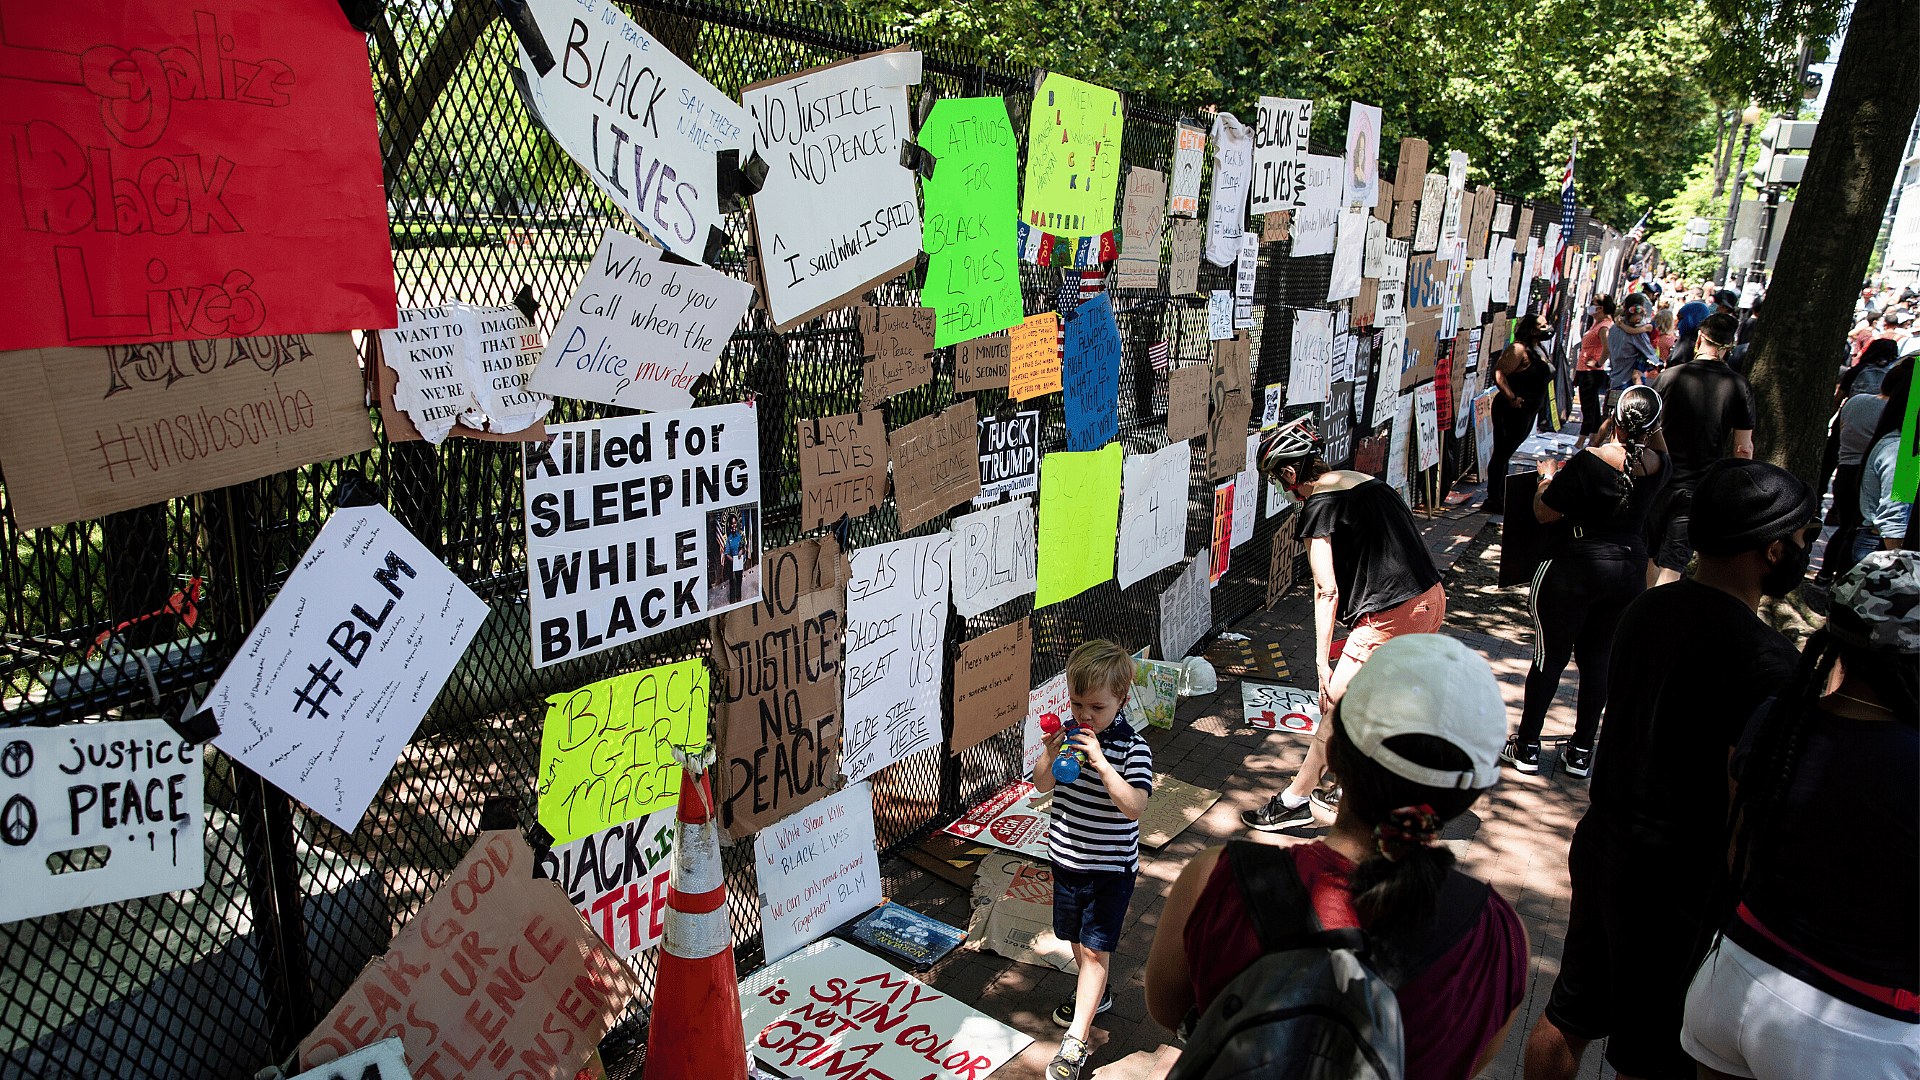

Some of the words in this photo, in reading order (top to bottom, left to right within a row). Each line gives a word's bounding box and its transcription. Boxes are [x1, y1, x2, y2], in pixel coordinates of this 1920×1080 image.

[620, 23, 650, 52] PEACE
[563, 18, 666, 138] BLACK
[678, 88, 705, 119] SAY
[710, 109, 741, 141] THEIR
[751, 95, 786, 149] NO
[1256, 107, 1293, 149] BLACK
[789, 143, 827, 184] NO
[1294, 103, 1311, 206] MATTER
[592, 114, 698, 245] LIVES
[962, 162, 992, 196] FOR
[1252, 160, 1293, 204] LIVES
[784, 253, 804, 288] I
[860, 220, 877, 247] I
[874, 200, 915, 238] SAID
[929, 214, 990, 254] BLACK
[54, 246, 266, 341] Lives
[604, 242, 652, 288] Who
[661, 272, 681, 298] do
[679, 288, 718, 315] you
[394, 326, 440, 344] WANT
[443, 323, 463, 338] TO
[400, 310, 414, 323] IF
[416, 306, 449, 321] YOU
[579, 293, 623, 321] Call
[630, 303, 680, 339] when
[686, 320, 712, 352] the
[881, 313, 909, 334] Justice
[942, 296, 995, 334] #BLM
[409, 344, 455, 363] KNOW
[481, 337, 516, 354] THAT
[520, 333, 542, 351] YOU
[482, 357, 512, 373] HAD
[555, 325, 628, 378] Police
[875, 336, 887, 359] No
[890, 337, 914, 358] Peace
[961, 346, 969, 365] 8
[976, 345, 1008, 360] MINUTES
[1092, 342, 1104, 363] TO
[1106, 336, 1117, 357] DO
[420, 364, 453, 382] WHY
[421, 383, 465, 401] WE'RE
[869, 365, 878, 387] No
[958, 370, 971, 385] 46
[976, 364, 1008, 379] SECONDS
[1069, 370, 1092, 399] WHAT
[1323, 390, 1350, 421] BLACK
[1327, 415, 1349, 440] LIVES
[90, 382, 315, 482] #unsubscribe
[526, 422, 652, 481] Killed
[665, 419, 725, 460] for
[900, 437, 932, 469] BLACK
[937, 428, 948, 448] IS
[951, 415, 975, 444] NOT
[988, 418, 1031, 451] FUCK
[1324, 436, 1350, 465] ATTER
[817, 445, 874, 476] LIVES
[910, 476, 919, 494] A
[930, 450, 969, 486] CRIME
[980, 446, 1033, 481] TRUMP
[530, 458, 749, 538] SLEEPING
[809, 475, 874, 519] MATTER
[1149, 491, 1159, 536] 4
[1236, 488, 1254, 510] LIVES
[537, 528, 698, 600] WHILE
[848, 548, 900, 600] GAS
[913, 538, 951, 600] US
[964, 507, 1034, 600] BLM
[751, 551, 799, 626] NO
[292, 550, 417, 720] #BLM
[540, 575, 701, 663] BLACK
[847, 613, 902, 655] SHOOT
[910, 601, 942, 652] US
[848, 648, 898, 699] BEAT
[909, 648, 935, 688] US
[558, 666, 708, 752] BLACK
[759, 689, 803, 744] NO
[885, 698, 916, 723] STILL
[59, 738, 195, 775] justice
[590, 708, 701, 776] GIRL
[890, 716, 926, 757] HERE
[723, 714, 835, 829] PEACE
[68, 774, 190, 835] PEACE
[561, 761, 681, 835] MAGI
[999, 819, 1021, 836] SIGN
[781, 842, 819, 875] BLACK
[821, 827, 849, 853] LIVES
[420, 834, 516, 950] GOOD
[786, 894, 800, 913] can
[804, 880, 821, 901] only
[837, 870, 866, 903] BLM
[440, 930, 500, 996] UR
[758, 979, 791, 1005] is
[810, 977, 909, 1036] SKIN
[854, 972, 944, 1013] MY
[790, 1003, 862, 1036] NOT
[895, 1023, 992, 1080] COLOR
